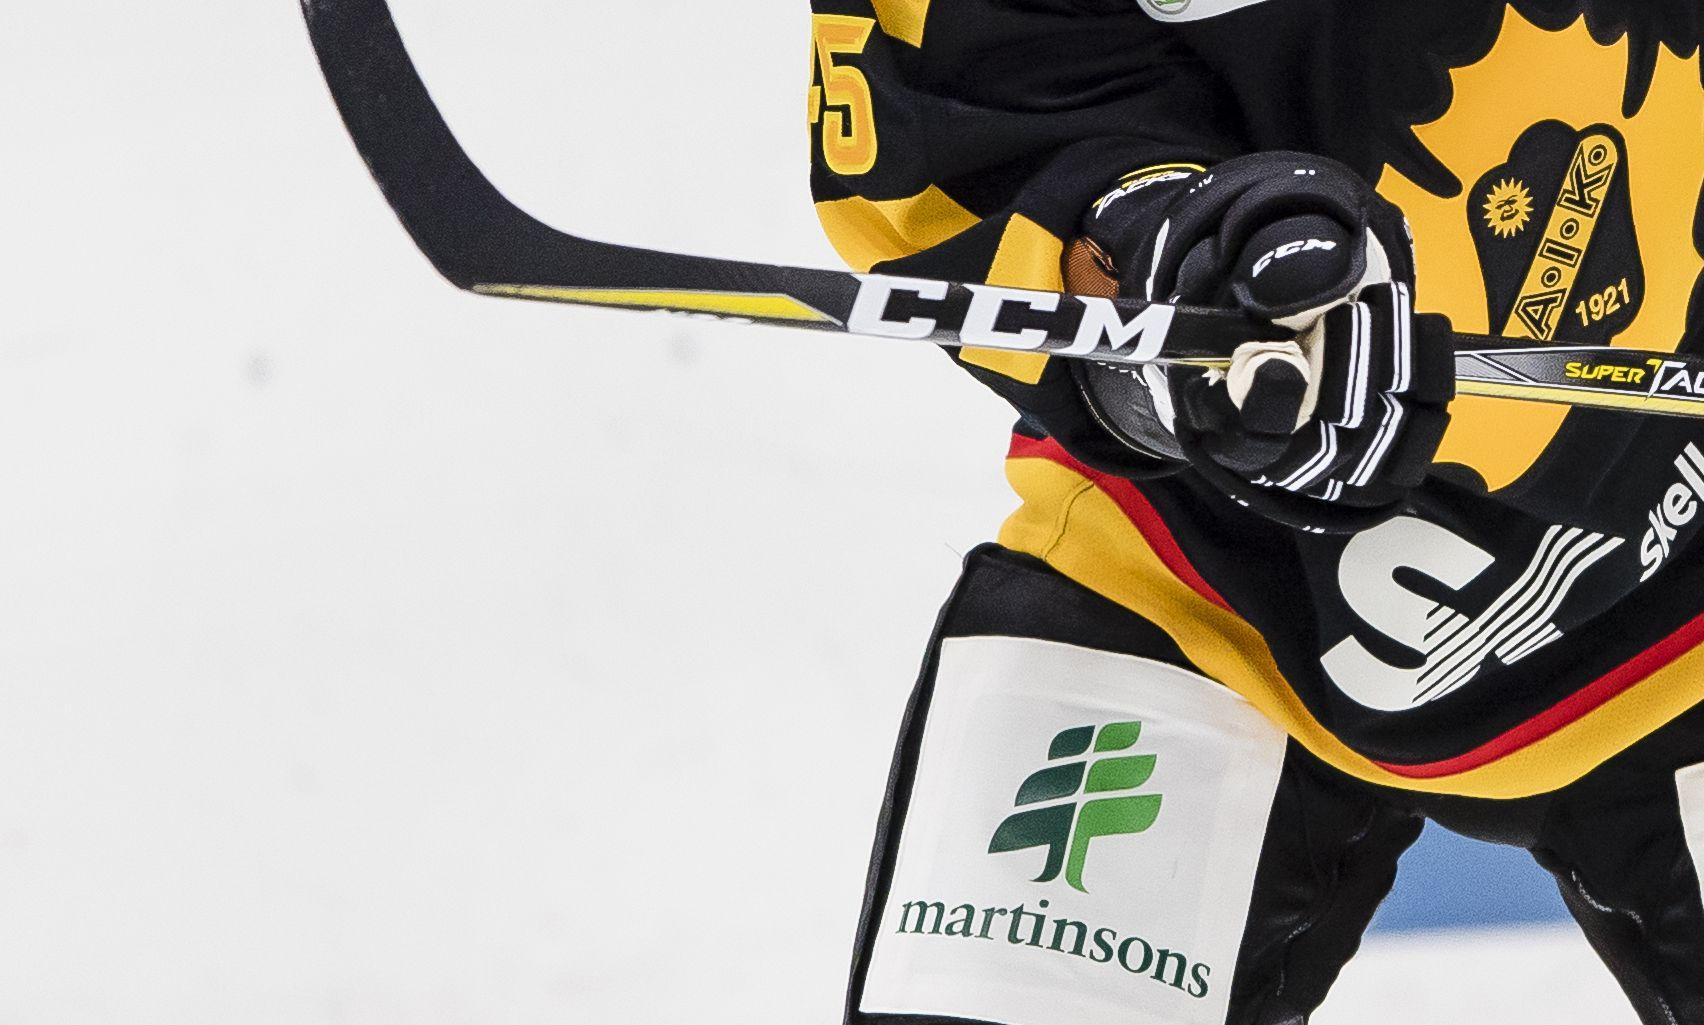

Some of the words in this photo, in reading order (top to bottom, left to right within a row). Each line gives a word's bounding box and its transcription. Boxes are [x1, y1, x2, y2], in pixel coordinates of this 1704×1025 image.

[808, 13, 877, 175] 5
[1252, 239, 1337, 278] CCM
[847, 273, 1176, 362] CCM
[1575, 277, 1631, 327] 1921
[1564, 361, 1646, 385] SUPER
[895, 898, 1212, 999] martinsons
